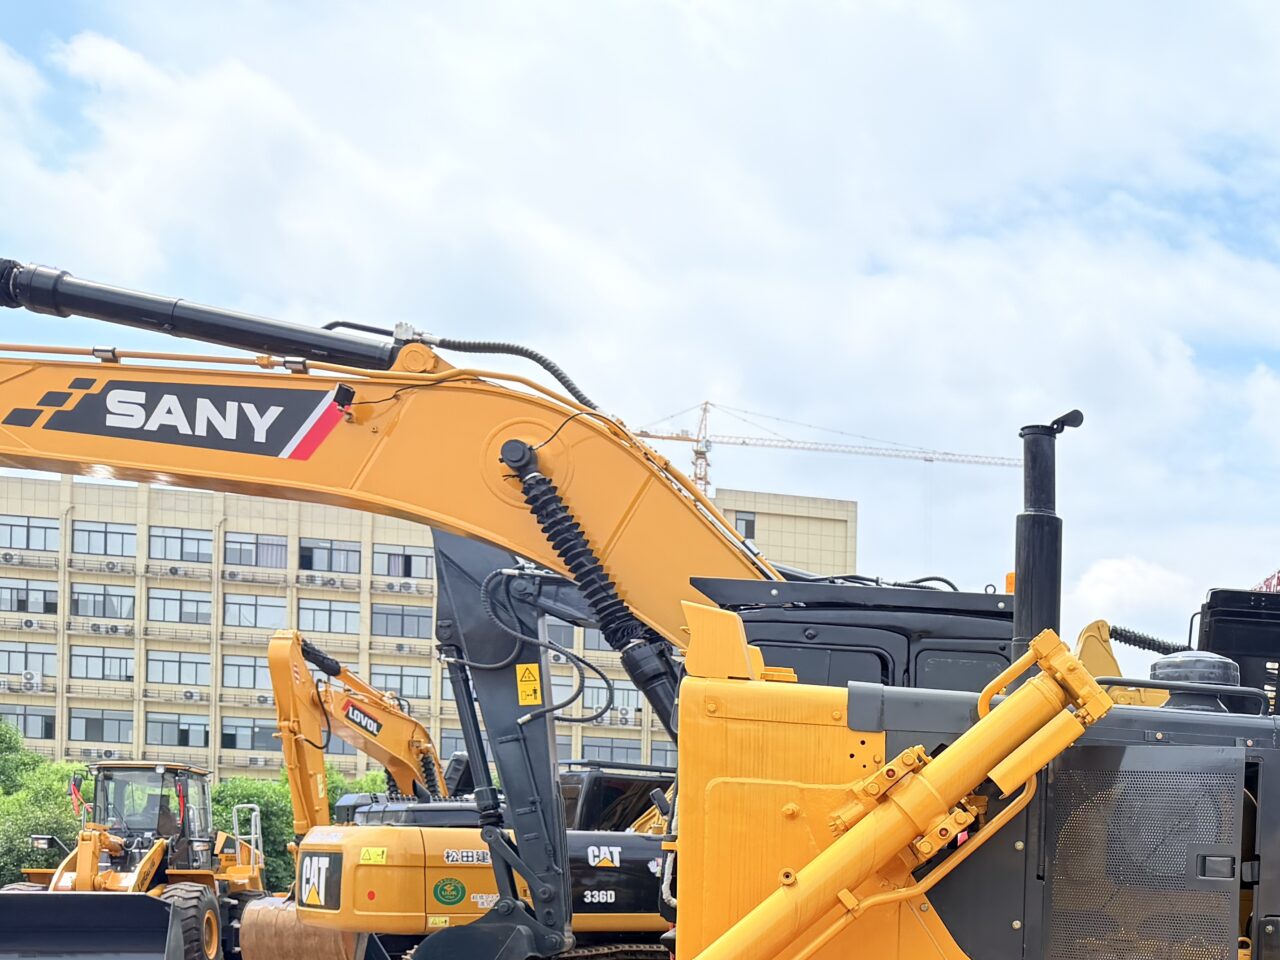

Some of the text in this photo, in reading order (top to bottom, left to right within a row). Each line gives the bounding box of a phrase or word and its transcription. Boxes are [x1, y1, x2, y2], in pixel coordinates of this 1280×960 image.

[105, 389, 284, 443] SANY
[348, 705, 379, 735] LOVOL
[587, 845, 622, 868] CAT
[301, 856, 330, 906] CAT
[583, 890, 616, 903] 336D
